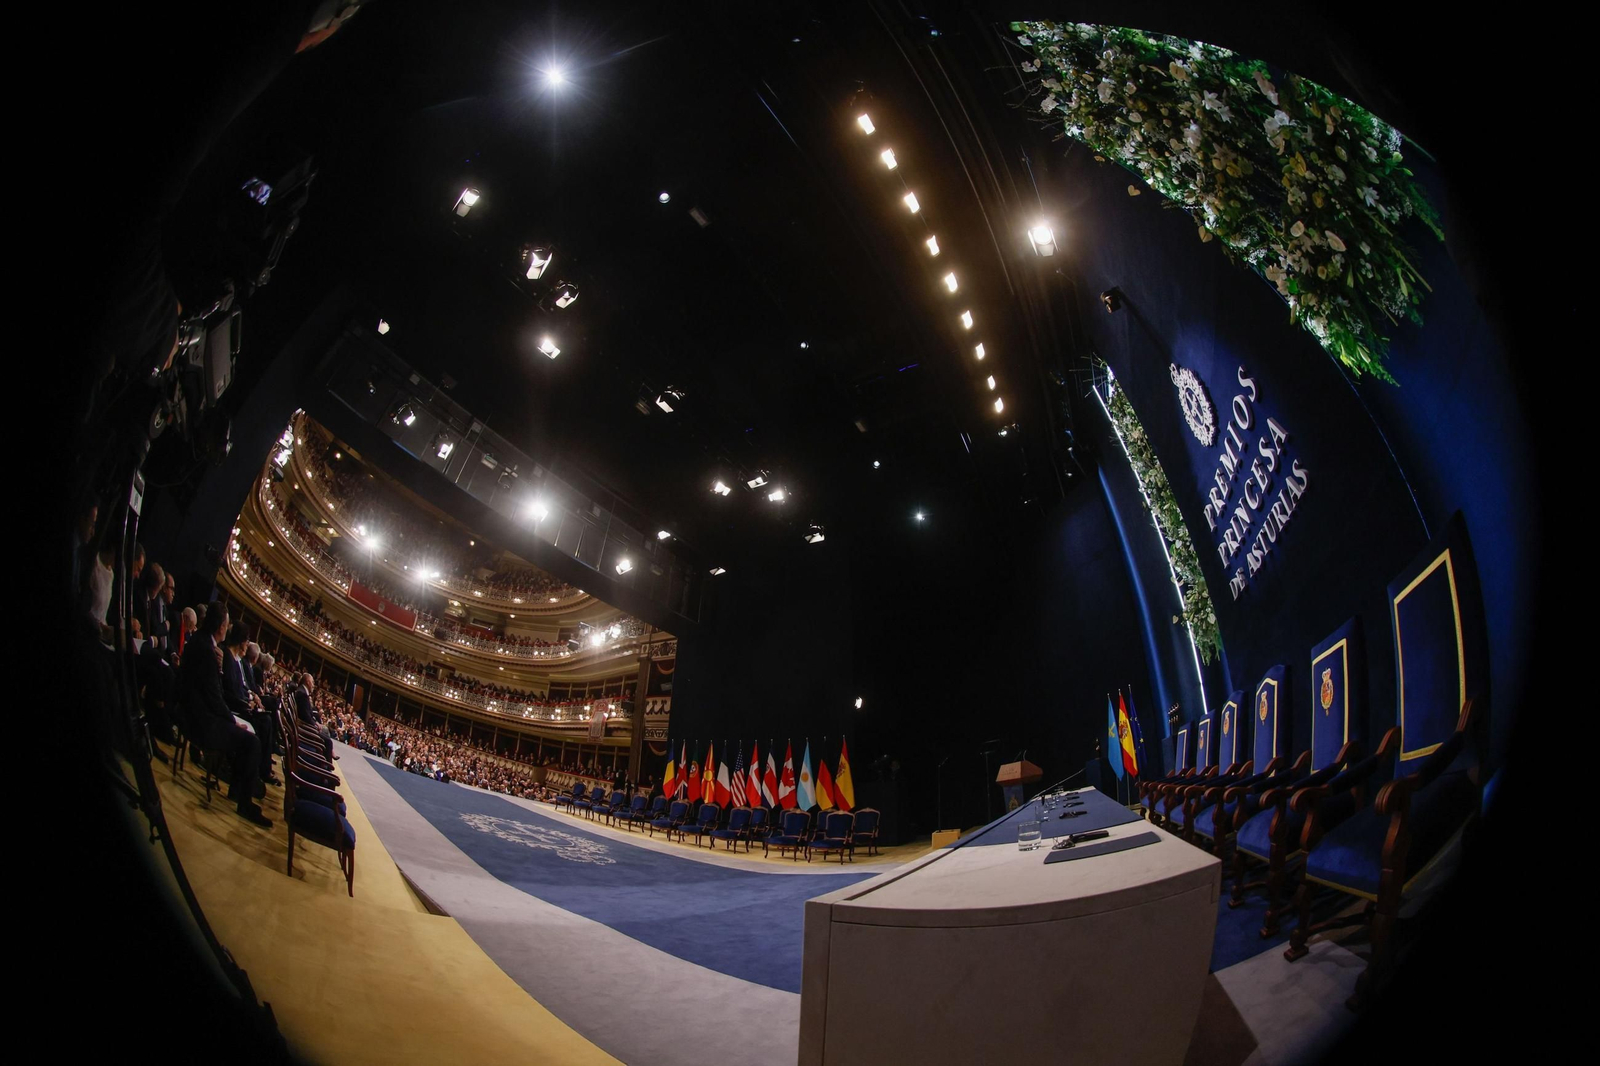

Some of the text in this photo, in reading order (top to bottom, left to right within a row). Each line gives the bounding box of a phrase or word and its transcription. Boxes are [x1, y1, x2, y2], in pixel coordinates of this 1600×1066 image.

[1203, 365, 1258, 532] PREMIOS
[1217, 416, 1289, 569] PRINCESA
[1229, 458, 1309, 601] DE ASTURIAS
